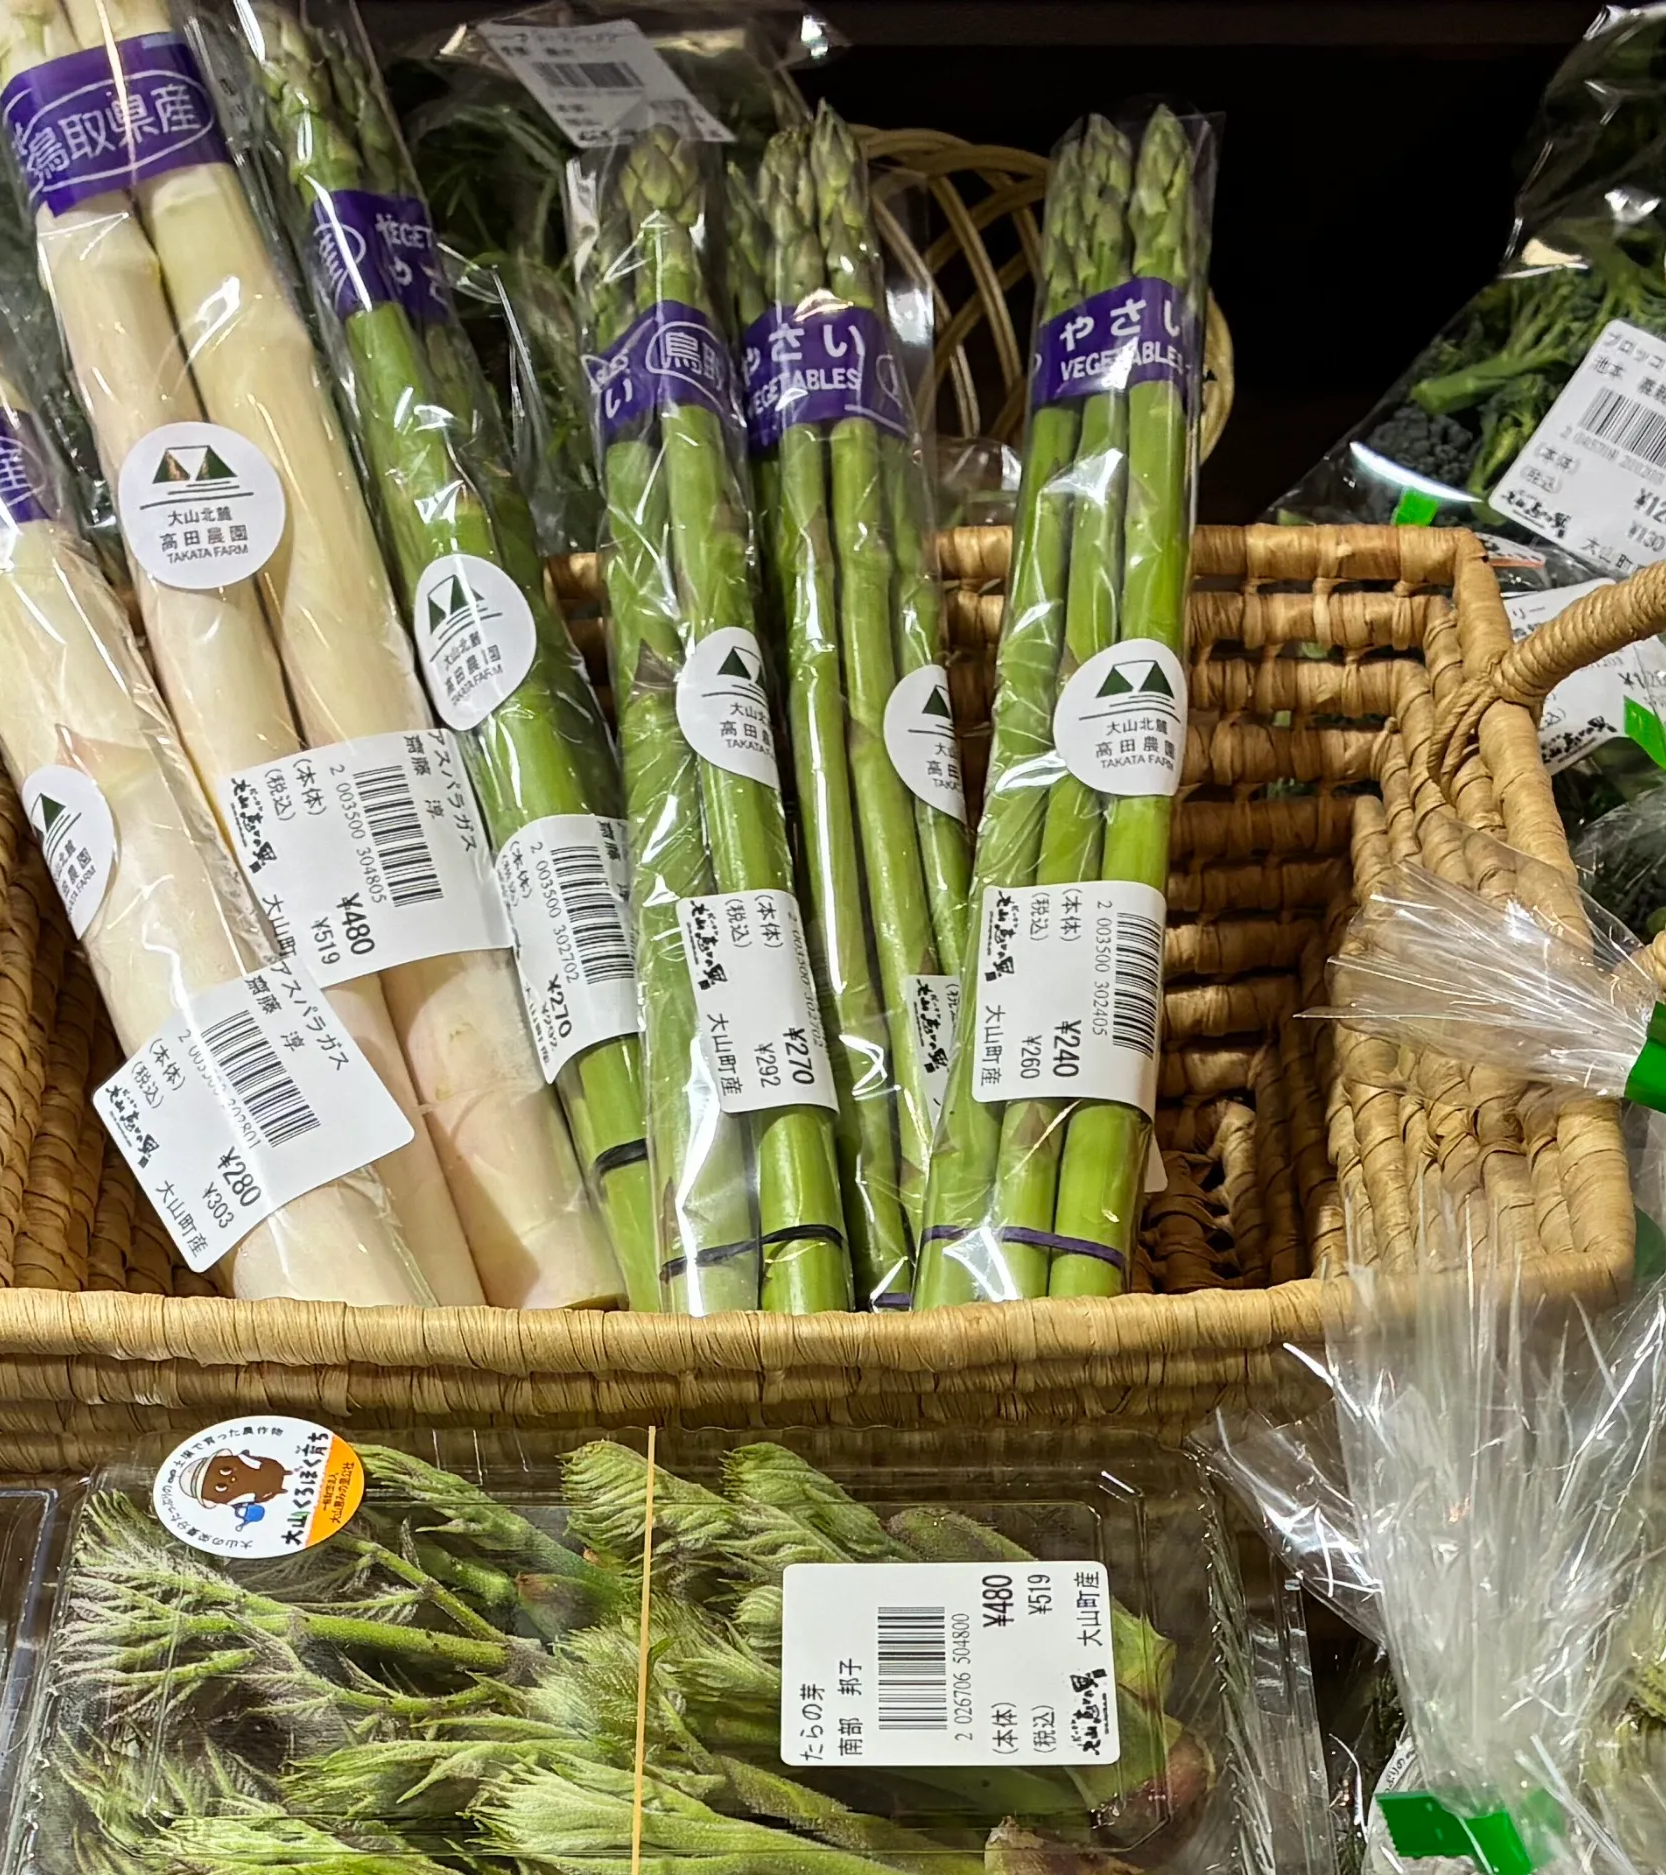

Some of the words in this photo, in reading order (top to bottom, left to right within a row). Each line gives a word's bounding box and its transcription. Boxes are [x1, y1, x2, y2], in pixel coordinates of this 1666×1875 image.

[26, 83, 201, 183] 鳥取県産
[168, 506, 233, 527] 大山北麓
[167, 548, 212, 564] TAKATA
[214, 544, 249, 558] FARM
[1106, 717, 1168, 736] 大山北麓
[426, 727, 479, 852] アスパラガス
[1101, 755, 1145, 769] TAKATA
[1148, 754, 1174, 772] FARM
[258, 766, 301, 822] (税込)
[304, 916, 345, 965] ¥519
[287, 756, 330, 817] (本体)
[329, 891, 380, 956] ¥480
[331, 781, 368, 840] 003500
[352, 846, 389, 904] 304805
[534, 857, 562, 921] 003500
[552, 922, 579, 986] 302702
[1028, 891, 1051, 942] (税込)
[1058, 887, 1084, 942] (本体)
[1093, 917, 1112, 972] 003500
[260, 958, 362, 1072] アスパラガス
[544, 971, 573, 1041] ¥270
[723, 897, 753, 948] (税込)
[751, 1042, 782, 1088] ¥292
[752, 893, 785, 949] (本体)
[780, 1027, 816, 1084] ¥270
[1090, 981, 1110, 1036] 302405
[705, 1013, 745, 1096] 大山町産
[980, 1004, 1005, 1088] 大山町産
[1019, 1033, 1042, 1080] ¥260
[1050, 1017, 1082, 1079] ¥240
[127, 1059, 167, 1111] (税込)
[197, 1181, 238, 1230] ¥303
[144, 1036, 190, 1093] (本体)
[211, 1145, 266, 1209] ¥280
[153, 1177, 212, 1258] 大山町産
[281, 1432, 329, 1546] 大山くろぼく育ち
[980, 1573, 1015, 1627] ¥480
[1025, 1573, 1052, 1614] ¥519
[1072, 1570, 1104, 1646] 大山町産
[950, 1612, 970, 1663] 504800
[838, 1656, 863, 1696] 邦子
[952, 1672, 972, 1724] 026706
[798, 1682, 826, 1761] たらの芽
[838, 1717, 863, 1755] 南部
[990, 1701, 1019, 1755] (本体)
[1030, 1704, 1058, 1753] (税込)
